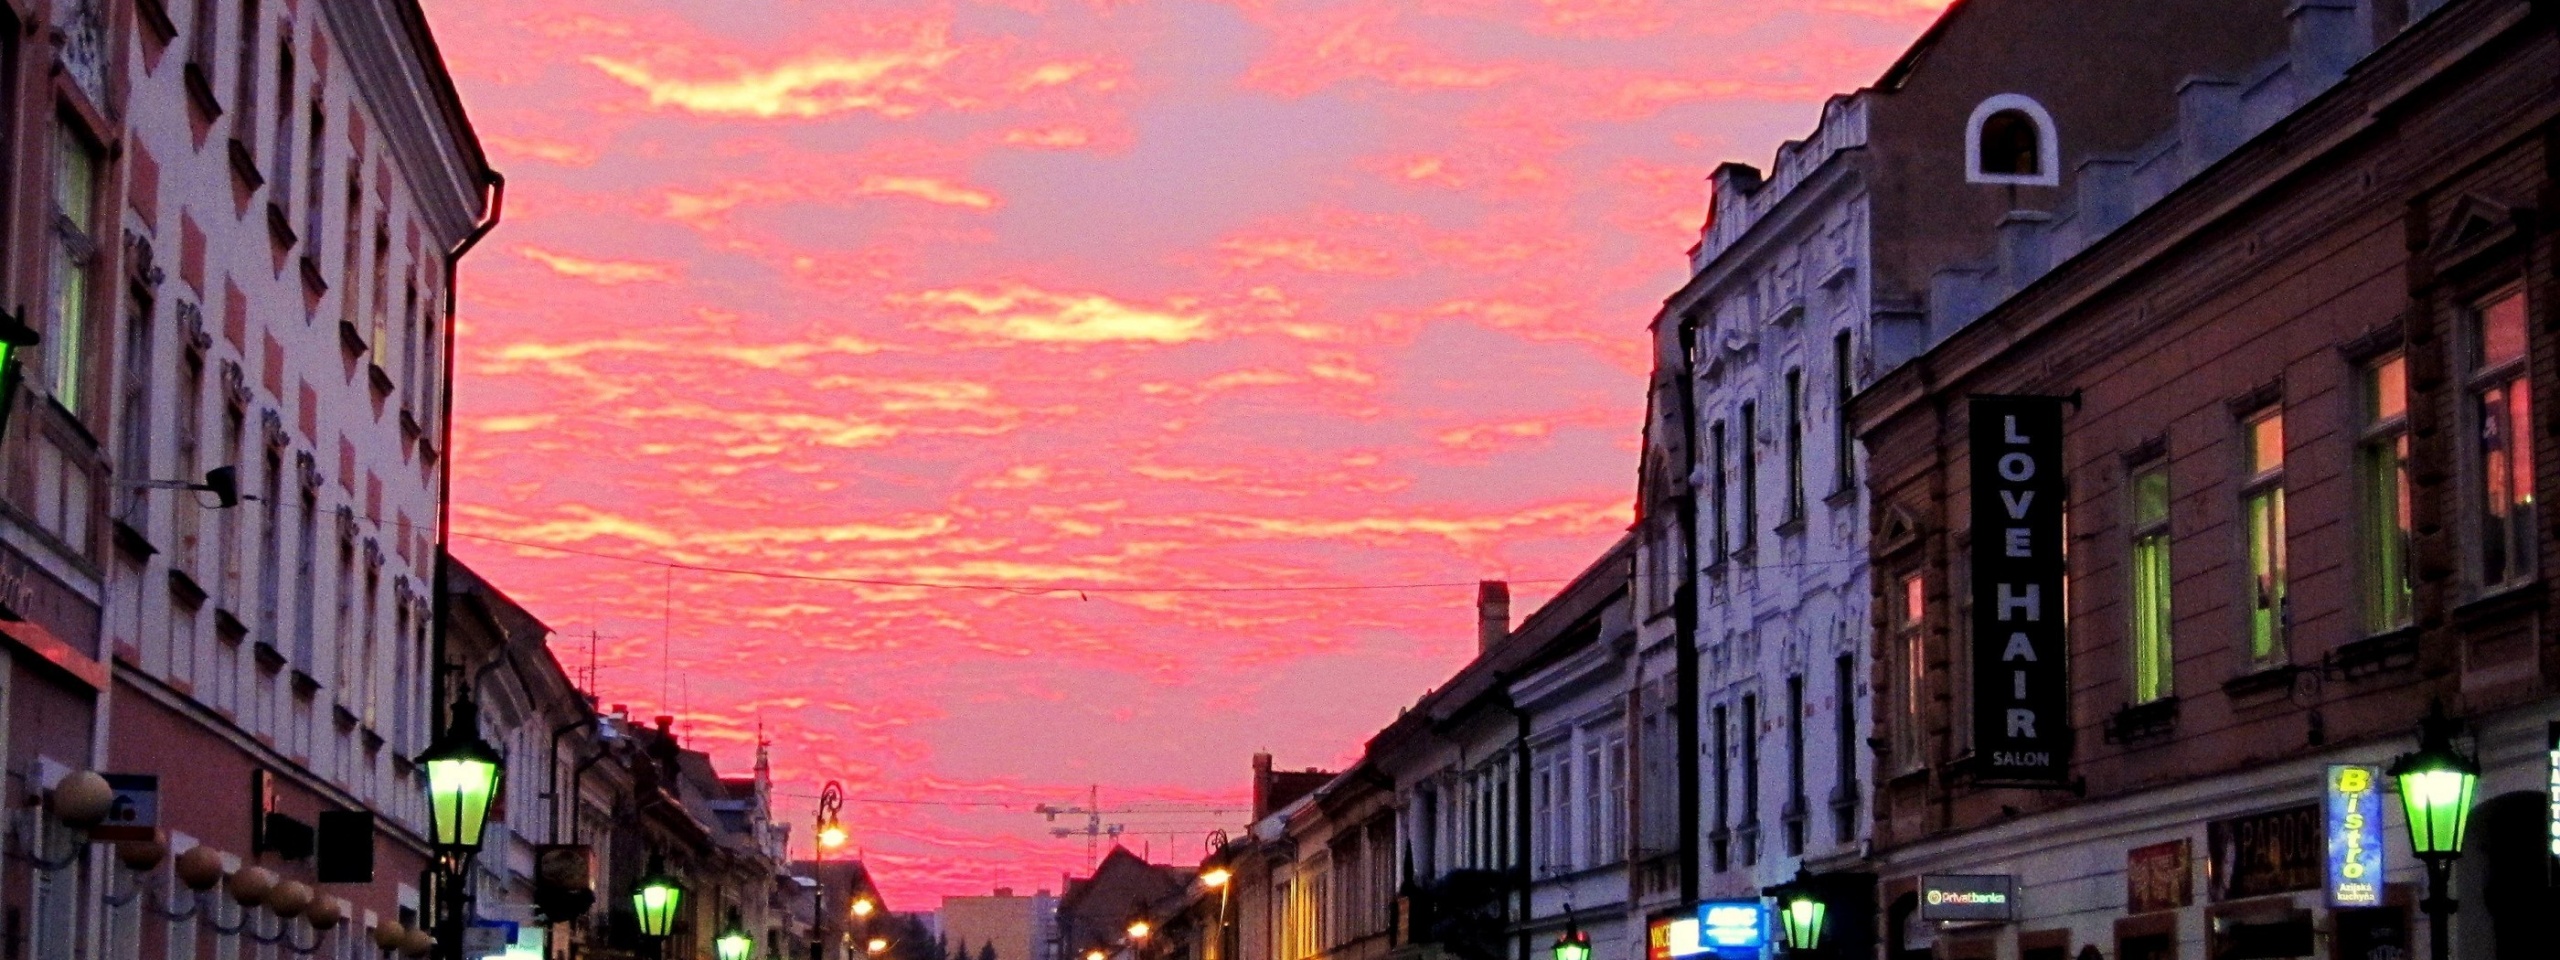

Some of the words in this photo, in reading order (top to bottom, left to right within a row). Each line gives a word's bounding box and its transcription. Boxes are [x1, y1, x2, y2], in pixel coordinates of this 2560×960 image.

[1998, 415, 2035, 557] LOVE
[1997, 583, 2040, 738] HAIR
[1993, 751, 2050, 767] SALON
[2340, 769, 2371, 879] Bistro
[1942, 891, 2006, 904] Privatbanka
